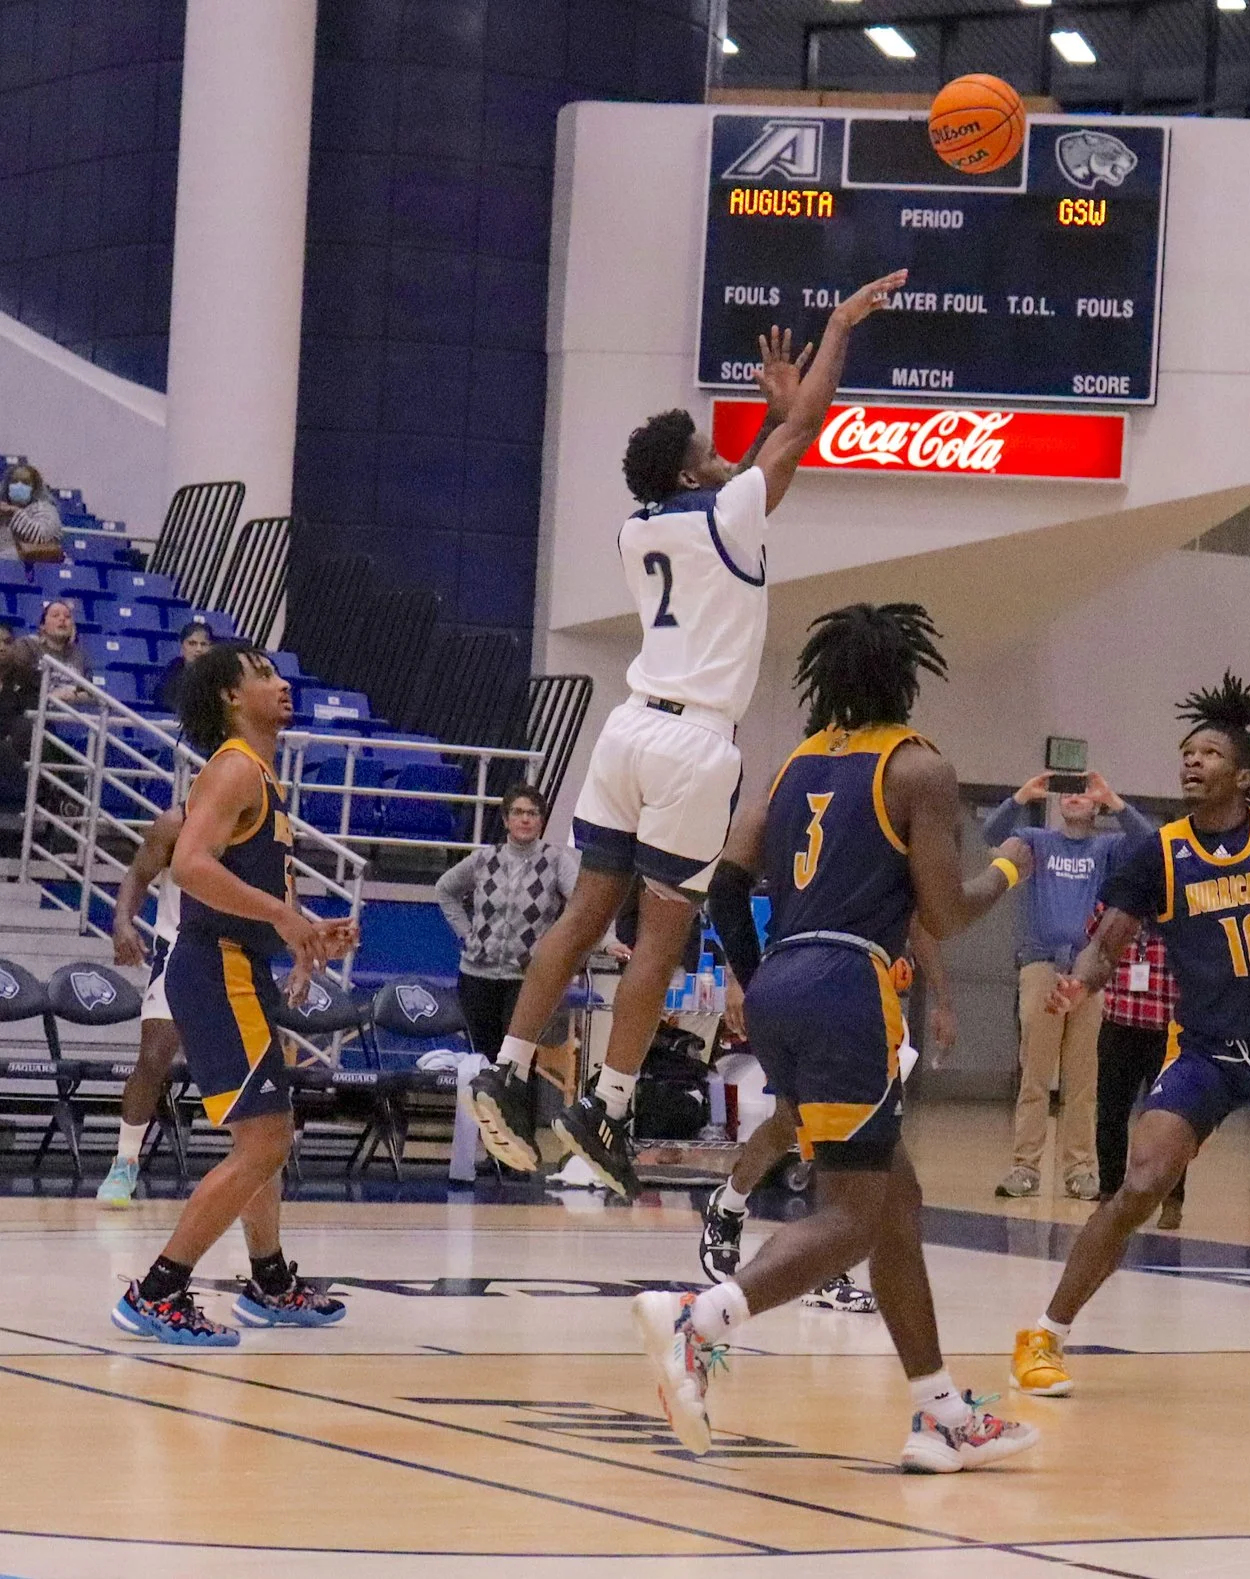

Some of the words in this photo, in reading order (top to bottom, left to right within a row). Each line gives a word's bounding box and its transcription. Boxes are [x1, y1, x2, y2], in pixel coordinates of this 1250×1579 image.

[729, 188, 833, 218] AUGUSTA
[1058, 198, 1106, 226] GSW
[901, 208, 964, 229] PERIOD
[725, 286, 780, 305] FOULS
[802, 289, 840, 308] T.O.L
[943, 294, 988, 314] FOUL
[1007, 296, 1056, 316] T.O.L.
[1077, 298, 1134, 318] FOULS
[720, 361, 764, 381] SCO
[892, 368, 954, 388] MATCH
[1073, 375, 1130, 395] SCORE
[818, 406, 1013, 470] Coca-Cola
[643, 551, 680, 628] 2
[793, 792, 835, 890] 3
[332, 1073, 377, 1084] JAGUARS
